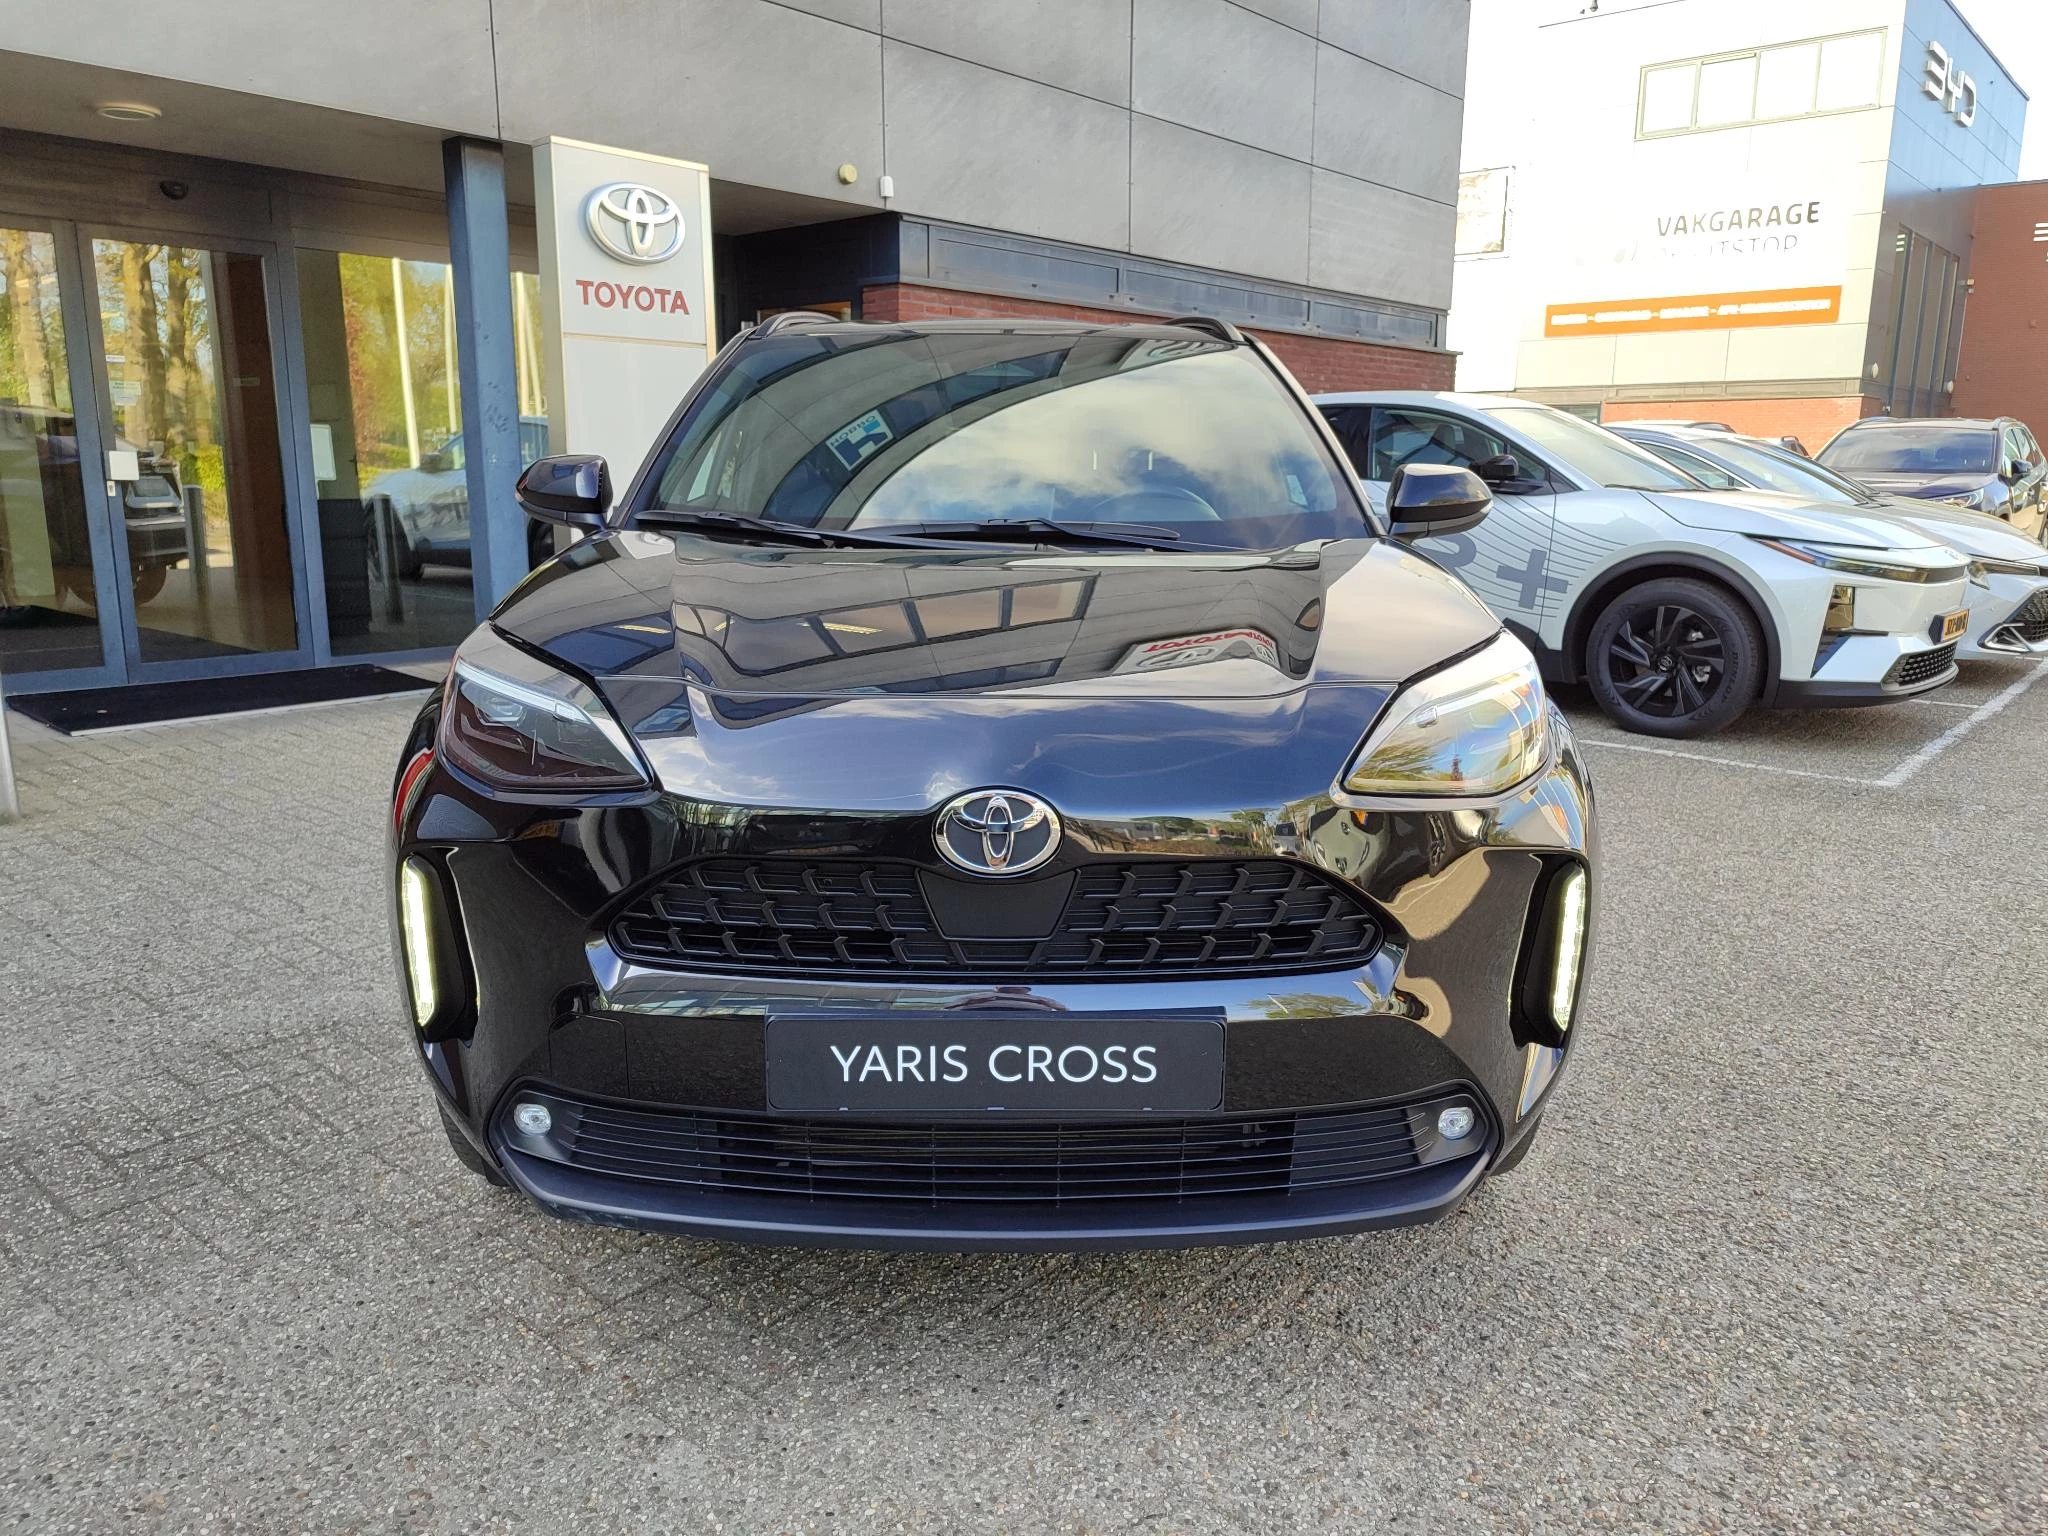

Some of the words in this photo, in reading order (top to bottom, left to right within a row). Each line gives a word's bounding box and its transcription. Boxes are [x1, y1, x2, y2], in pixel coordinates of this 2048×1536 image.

[1922, 39, 1977, 128] BYD
[1656, 201, 1821, 237] VAKGARAGE
[575, 279, 690, 315] TOYOTA
[830, 1045, 968, 1083] YARIS
[988, 1045, 1158, 1083] CROSS
